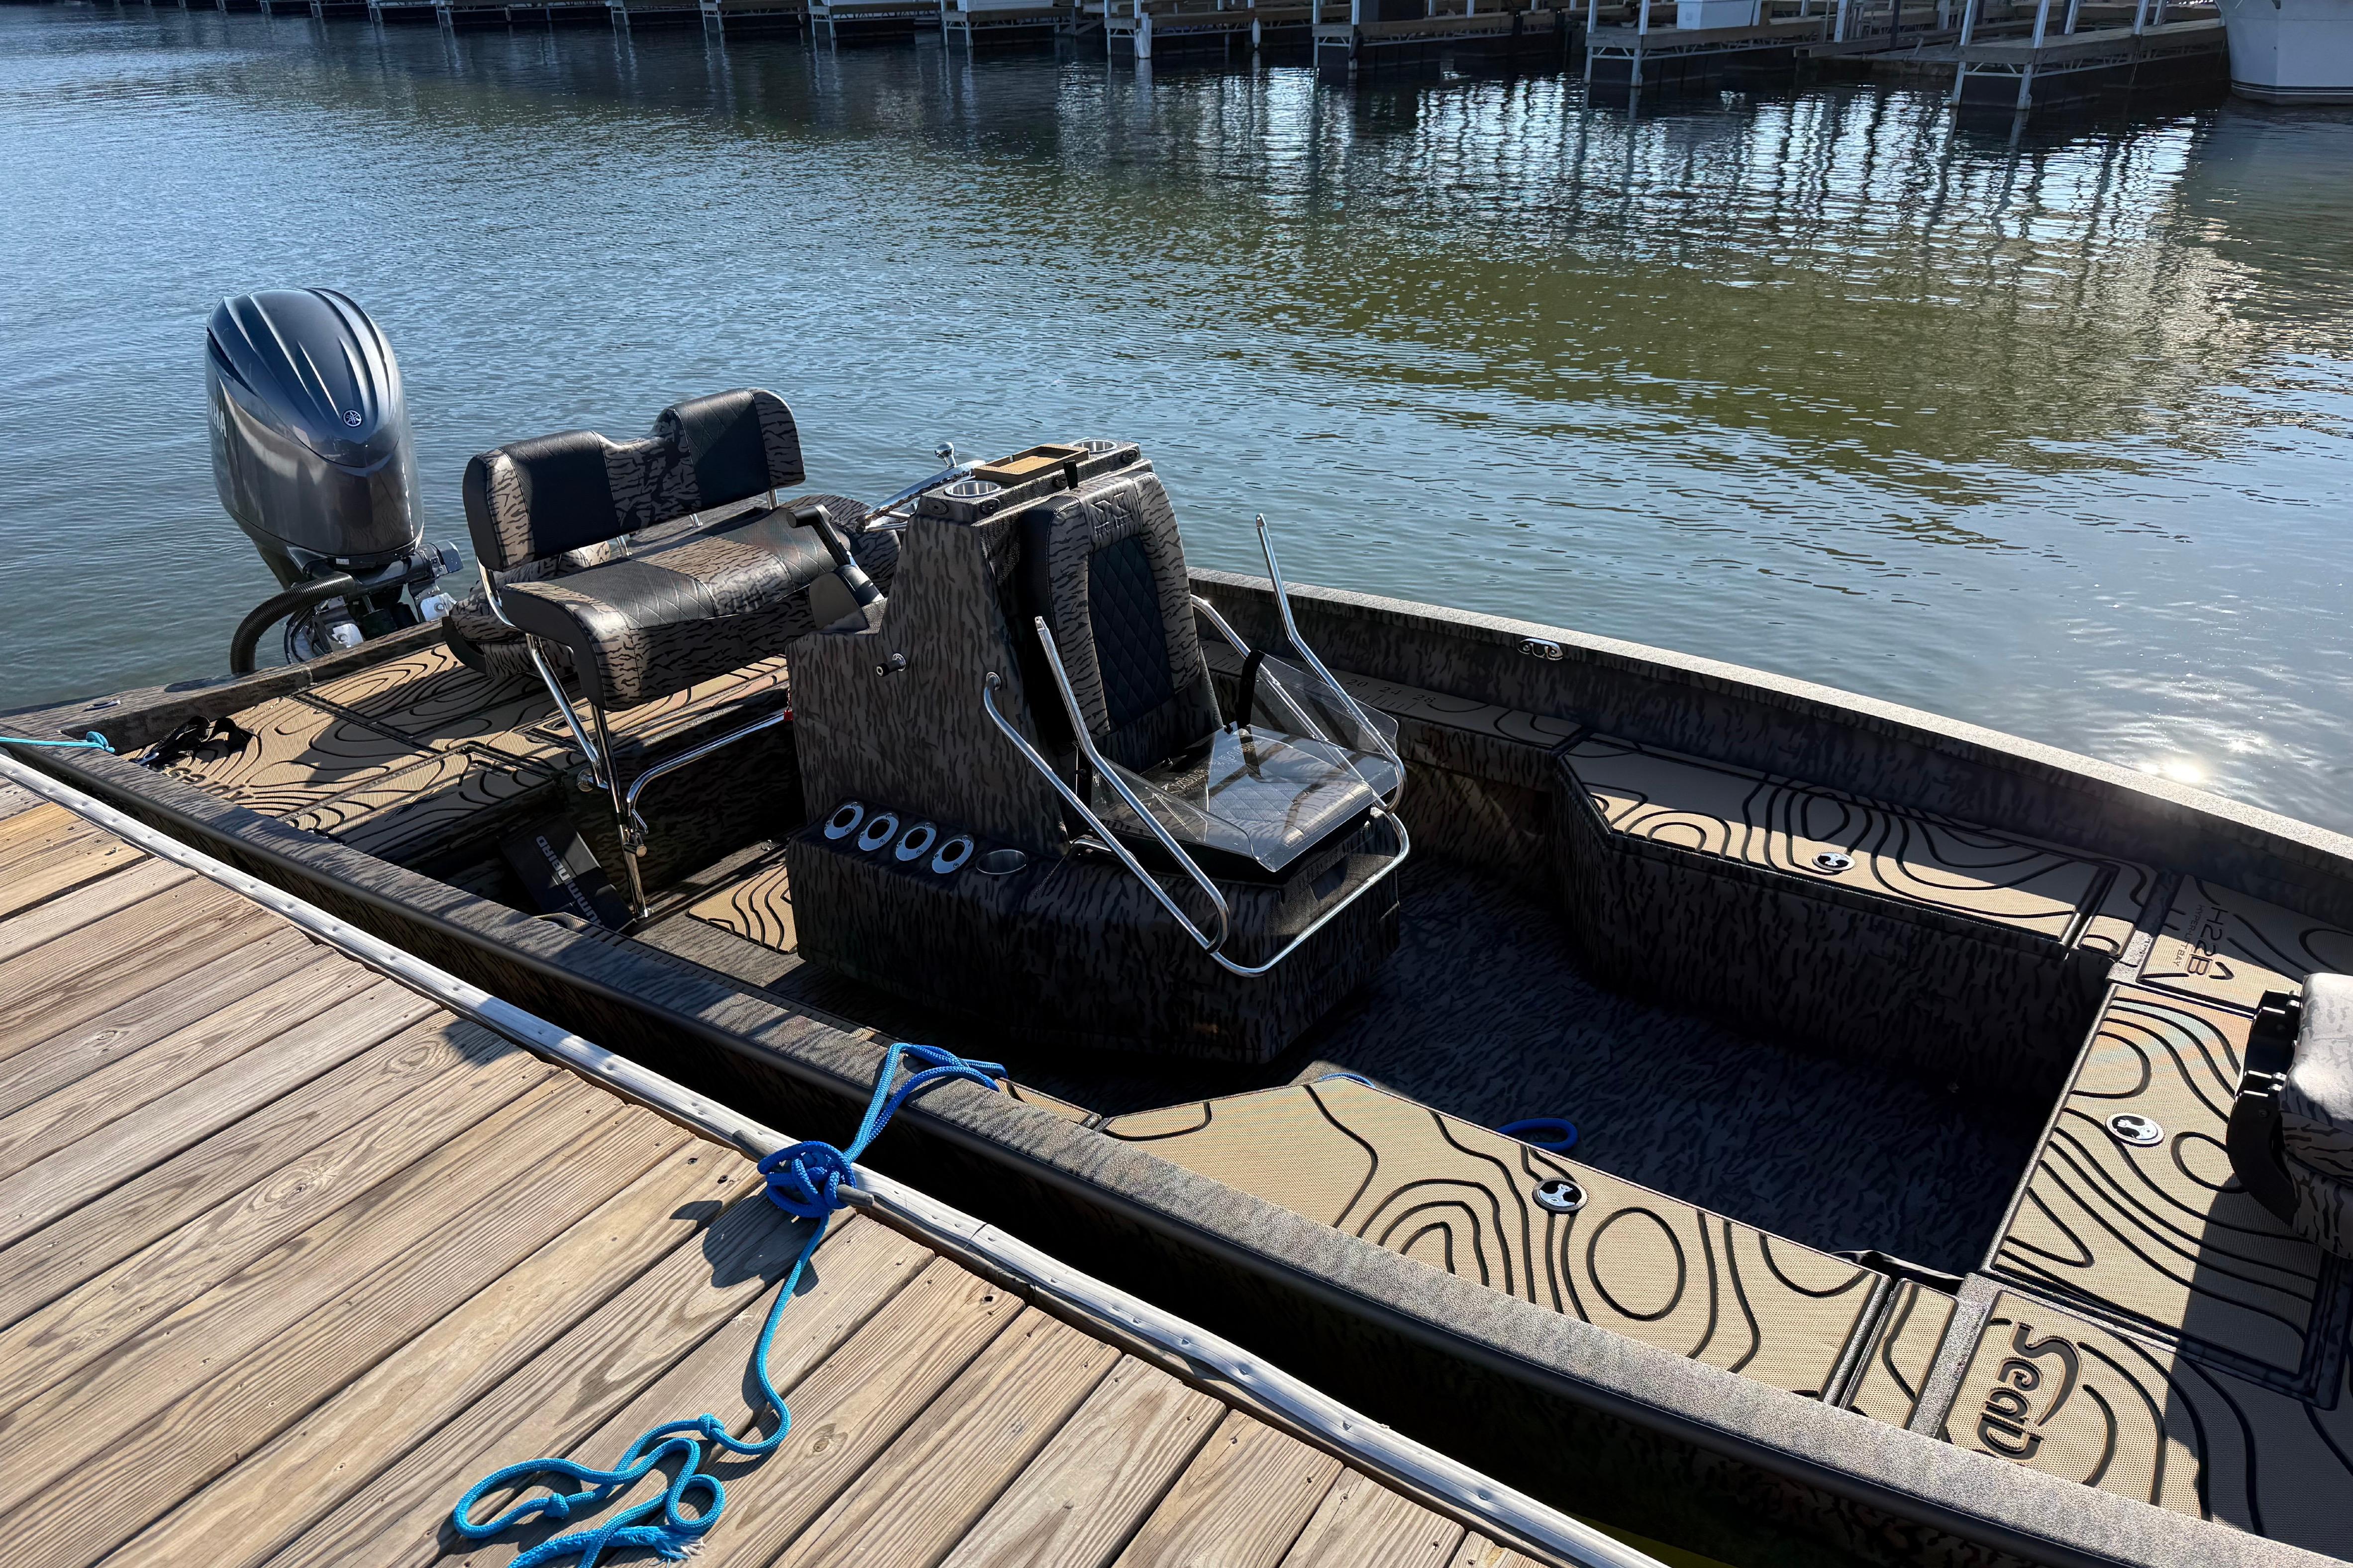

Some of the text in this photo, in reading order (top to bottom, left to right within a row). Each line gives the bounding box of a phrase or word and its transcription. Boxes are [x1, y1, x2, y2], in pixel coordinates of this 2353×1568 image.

[1346, 679, 1368, 687] 20
[1379, 686, 1402, 695] 24
[1412, 694, 1436, 703] 28
[2172, 949, 2185, 967] BAY
[2187, 906, 2229, 976] H22B
[1974, 1322, 2082, 1462] SeaD
